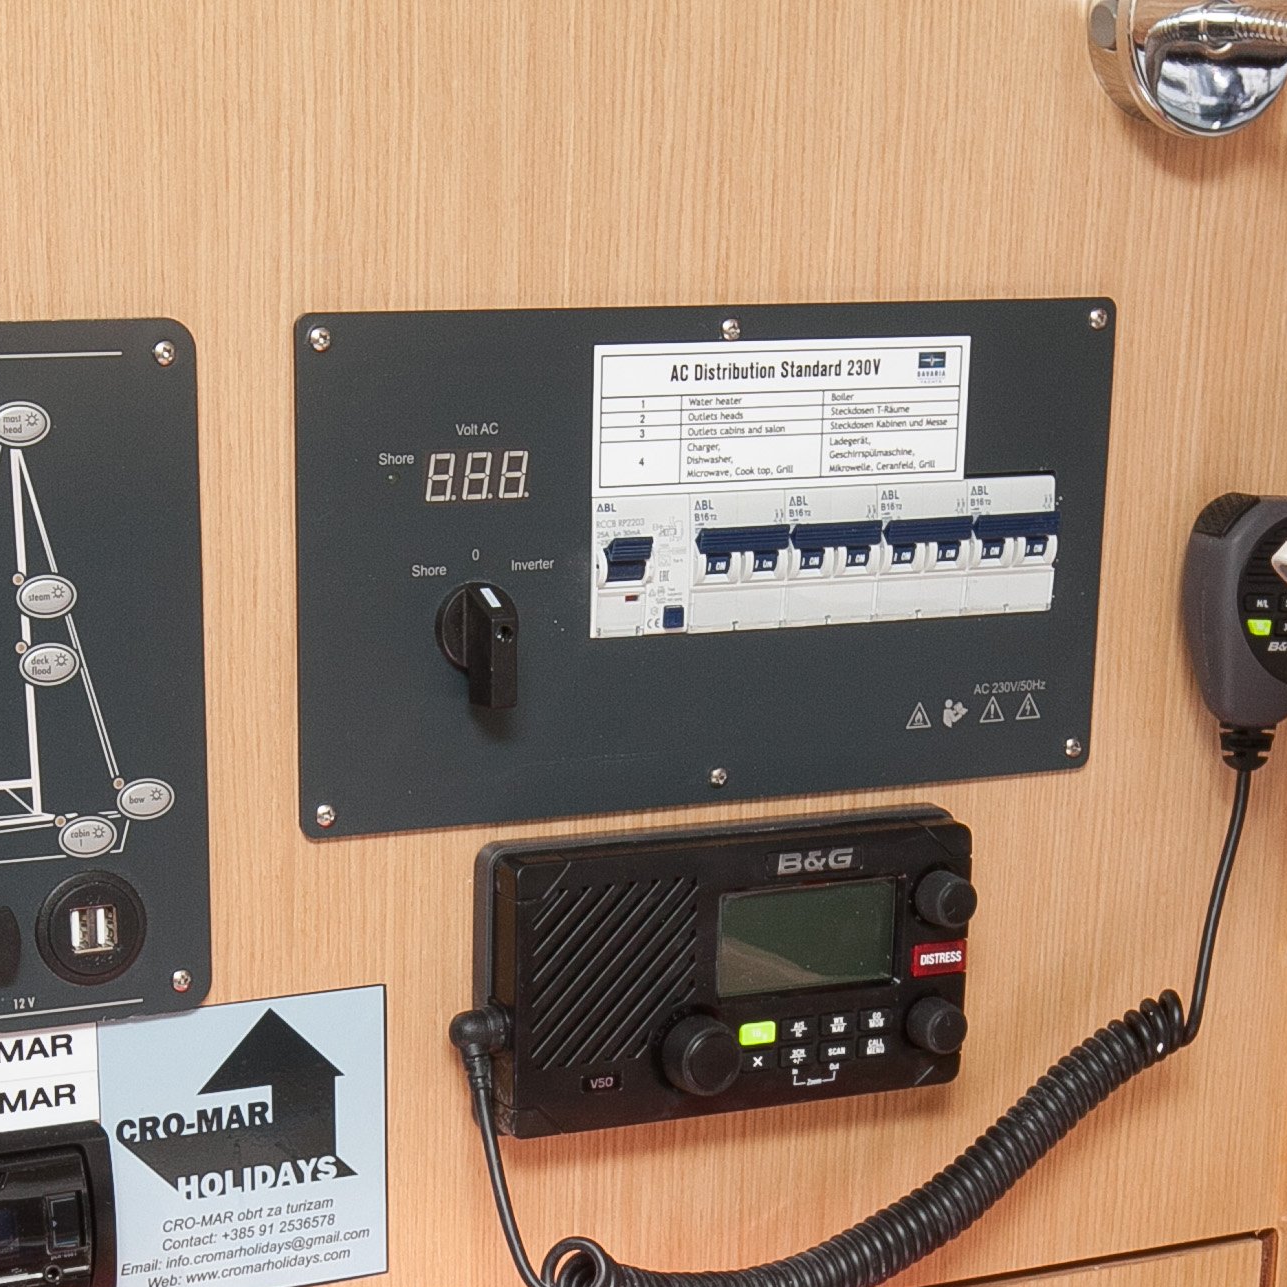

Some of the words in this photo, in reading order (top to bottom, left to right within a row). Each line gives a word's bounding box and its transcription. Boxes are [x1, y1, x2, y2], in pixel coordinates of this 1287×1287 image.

[670, 364, 688, 382] AC
[694, 360, 775, 381] Distribution
[780, 359, 842, 379] Standard
[847, 358, 881, 377] 230V
[688, 397, 714, 406] Water
[715, 396, 742, 406] heater
[830, 392, 855, 402] Boiler
[688, 412, 718, 422] Outlets
[720, 410, 744, 421] heads
[830, 406, 875, 416] Steckdosen
[2, 414, 22, 424] mast
[829, 420, 875, 430] Steckdosen
[876, 418, 907, 428] Kabinen
[908, 418, 924, 427] und
[925, 417, 948, 427] Messe
[2, 424, 23, 435] head
[455, 423, 478, 436] Volt
[480, 422, 499, 435] AC
[687, 426, 718, 436] Outlets
[719, 425, 746, 435] cabins
[747, 424, 764, 434] and
[765, 424, 786, 433] salon
[687, 442, 721, 453] Charger,
[378, 452, 415, 465] Shore
[918, 459, 936, 469] Grill
[735, 466, 756, 476] Cook
[776, 464, 794, 475] Grill
[411, 564, 447, 577] Shore
[511, 558, 555, 571] Inverter
[27, 593, 51, 602] steam
[30, 656, 50, 666] deck
[30, 666, 52, 676] flood
[973, 683, 990, 695] AC
[992, 679, 1046, 694] 230V/50Hz
[128, 795, 145, 805] bow
[69, 829, 91, 839] cabin
[777, 847, 854, 875] B&G
[919, 948, 962, 967] DISTRESS
[13, 998, 25, 1010] 12
[27, 996, 36, 1008] V
[828, 1046, 846, 1056] SCAN
[590, 1076, 615, 1091] V50
[115, 1101, 270, 1144] CRO-MAR
[177, 1154, 339, 1200] HOLIDAYS
[162, 1212, 234, 1233] CRO-MAR
[237, 1206, 263, 1221] obrt
[267, 1206, 282, 1217] za
[285, 1198, 334, 1215] turizam
[162, 1232, 217, 1252] Contact:
[221, 1225, 255, 1241] +385
[258, 1223, 274, 1238] 91
[279, 1214, 335, 1235] 2536578
[120, 1259, 164, 1276] Email:
[165, 1227, 370, 1269] info.cromarholidays@gmail.com
[185, 1247, 351, 1284] www.cromarholidays.com
